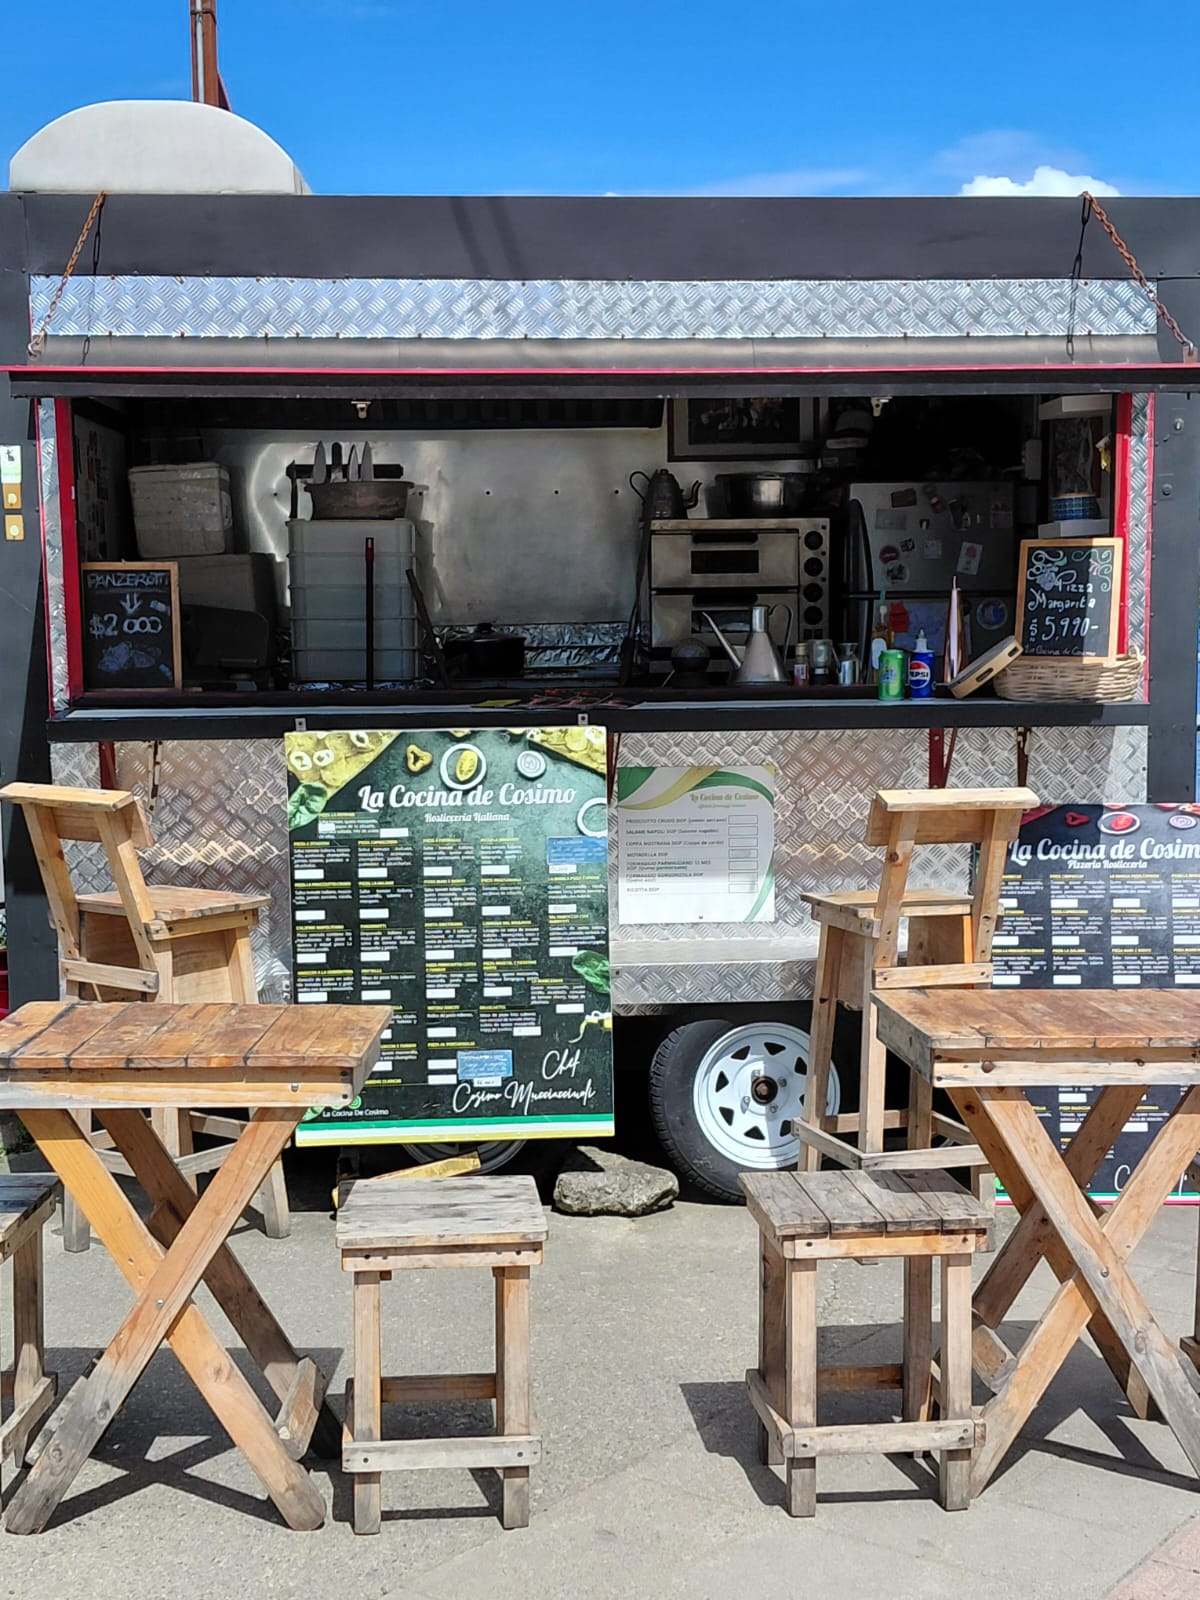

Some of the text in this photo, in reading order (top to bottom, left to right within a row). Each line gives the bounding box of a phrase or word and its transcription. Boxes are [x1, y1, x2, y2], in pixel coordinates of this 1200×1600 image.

[1055, 570, 1094, 592] Pizza
[1028, 588, 1097, 613] Margarita
[358, 783, 577, 813] La Cocina de Cosimo
[1008, 837, 1200, 867] La Cocina de Cosim
[1067, 860, 1102, 870] Pizzeria
[542, 1048, 581, 1080] Chef
[452, 1083, 503, 1113] Cosimo
[364, 1108, 389, 1116] Cosimo
